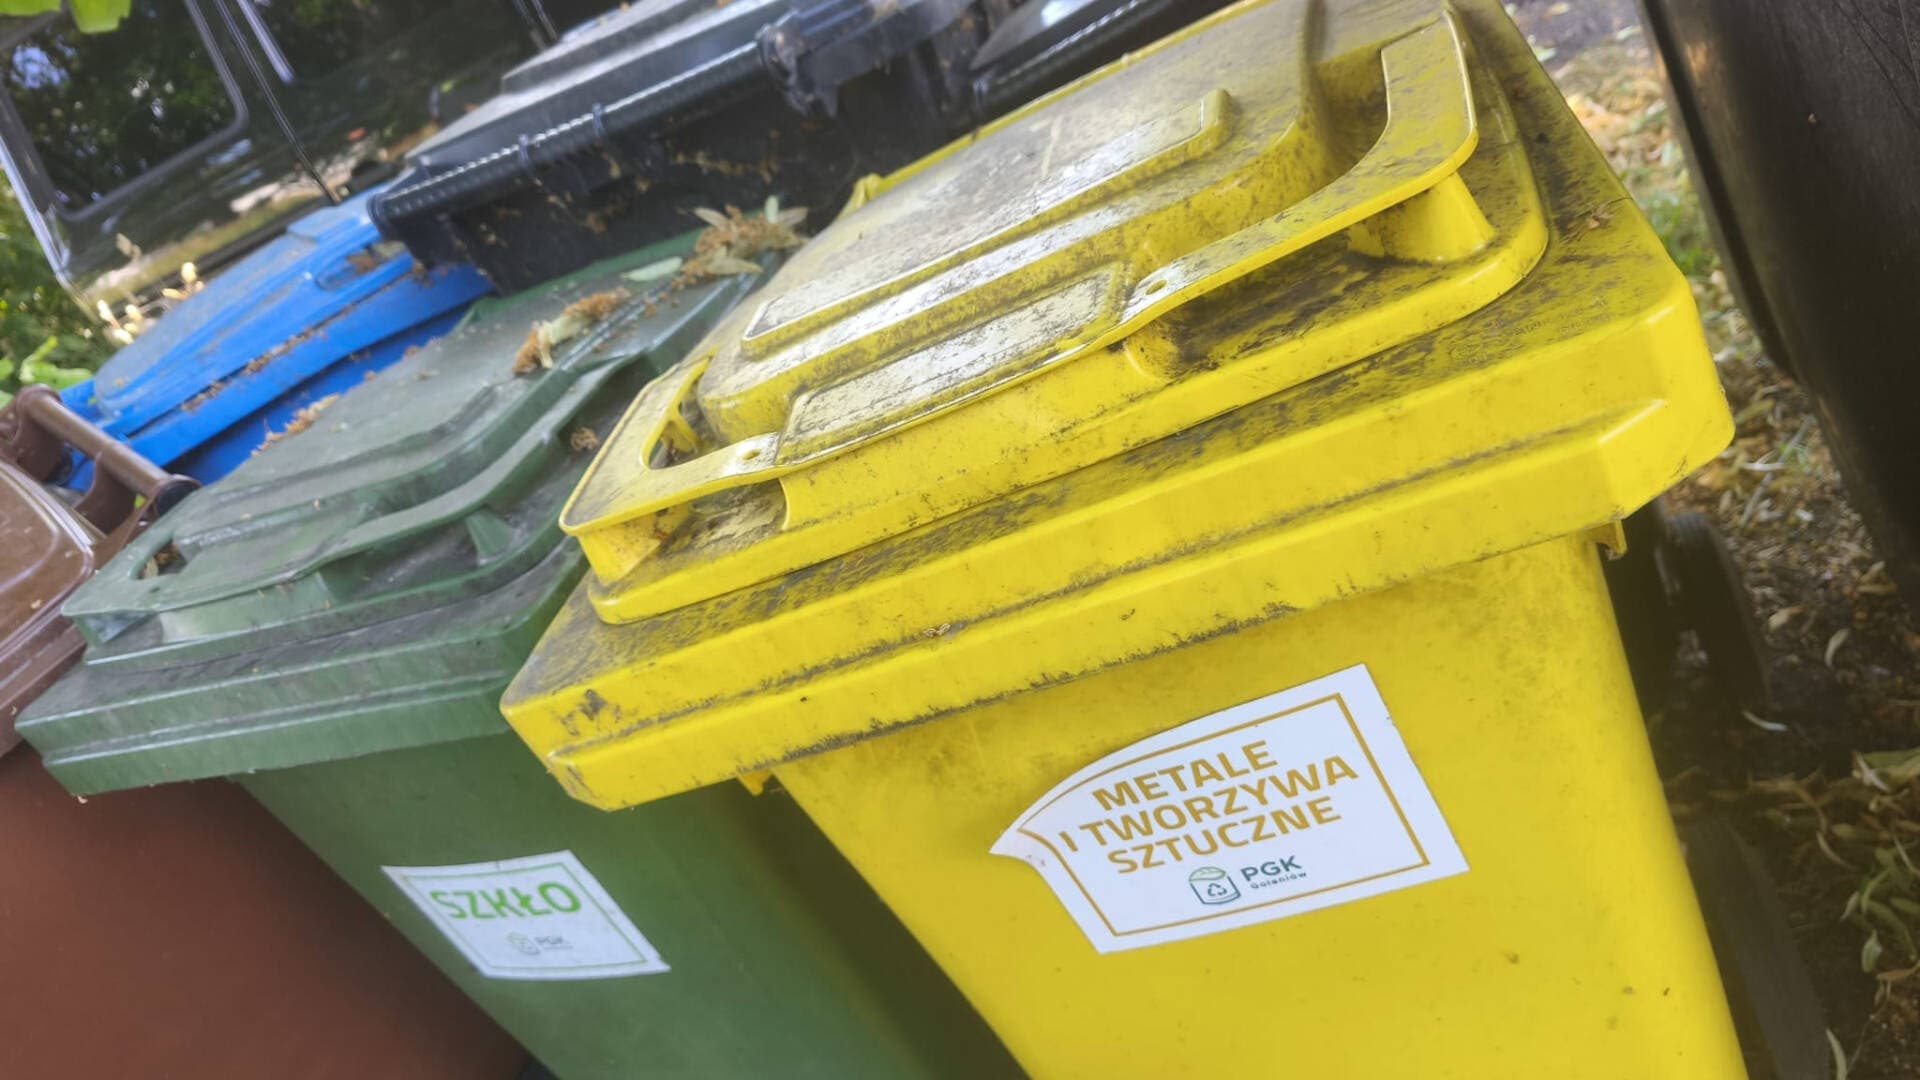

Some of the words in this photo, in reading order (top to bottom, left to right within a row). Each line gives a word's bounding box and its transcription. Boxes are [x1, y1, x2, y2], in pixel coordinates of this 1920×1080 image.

[1058, 831, 1078, 853] I
[1079, 755, 1359, 847] TWORZYWA
[1093, 740, 1278, 811] METALE
[1107, 796, 1341, 874] SZTUCZNE
[1240, 855, 1302, 882] PGK
[430, 882, 582, 919] SZKŁO
